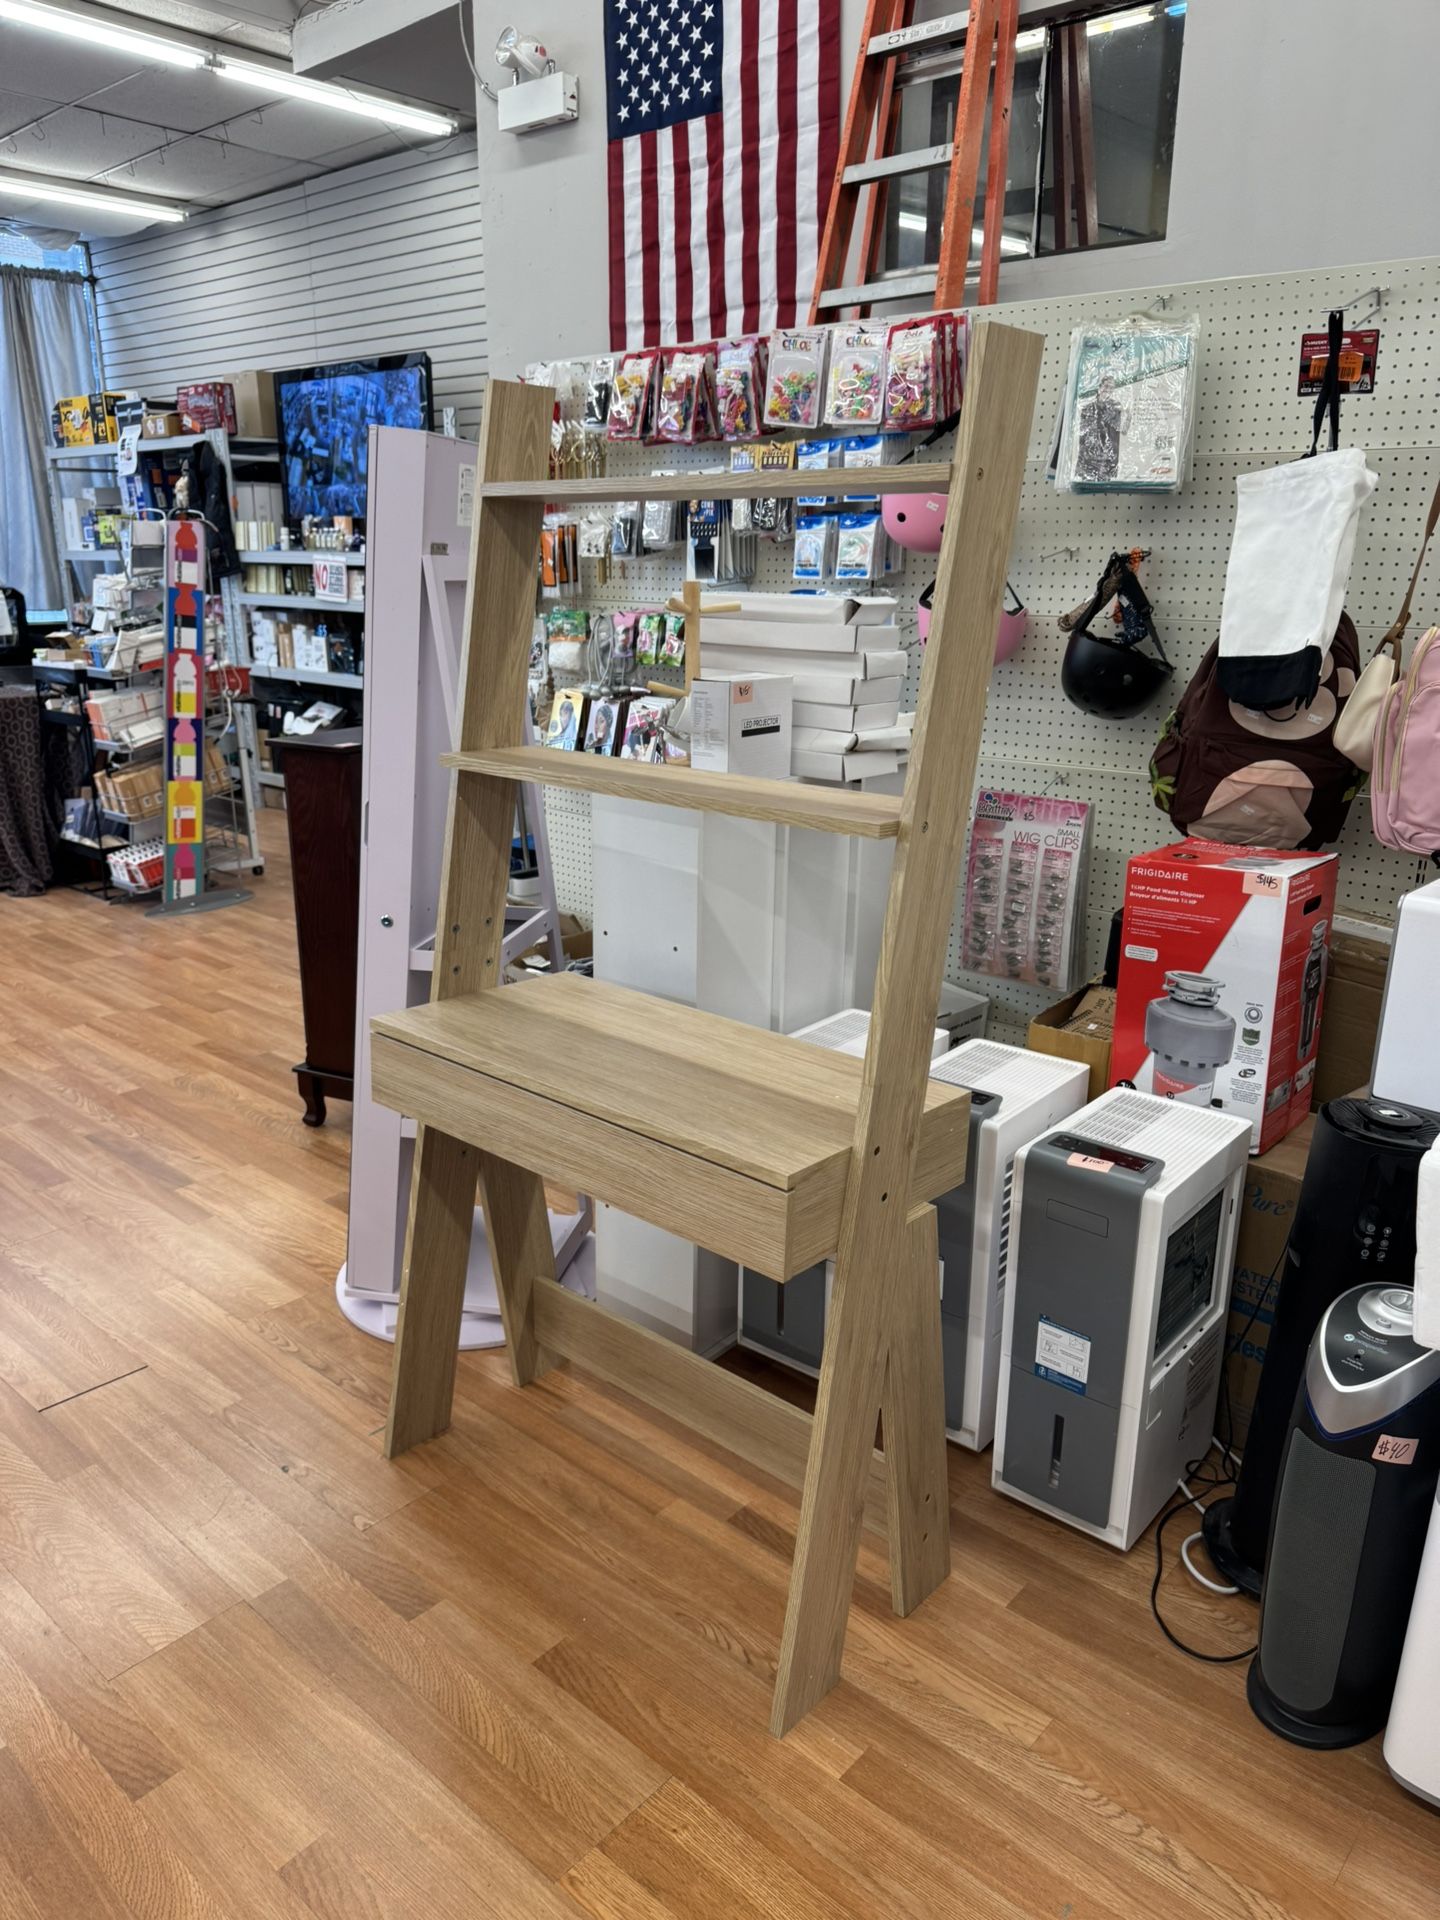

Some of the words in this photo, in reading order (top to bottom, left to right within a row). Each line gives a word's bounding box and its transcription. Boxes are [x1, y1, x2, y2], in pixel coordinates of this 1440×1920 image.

[1014, 830, 1041, 845] WIG
[1044, 834, 1080, 851] CLIPS
[1057, 828, 1081, 839] SMALL
[1131, 866, 1189, 881] FRIGIDAIRE
[1378, 1440, 1410, 1459] $40
